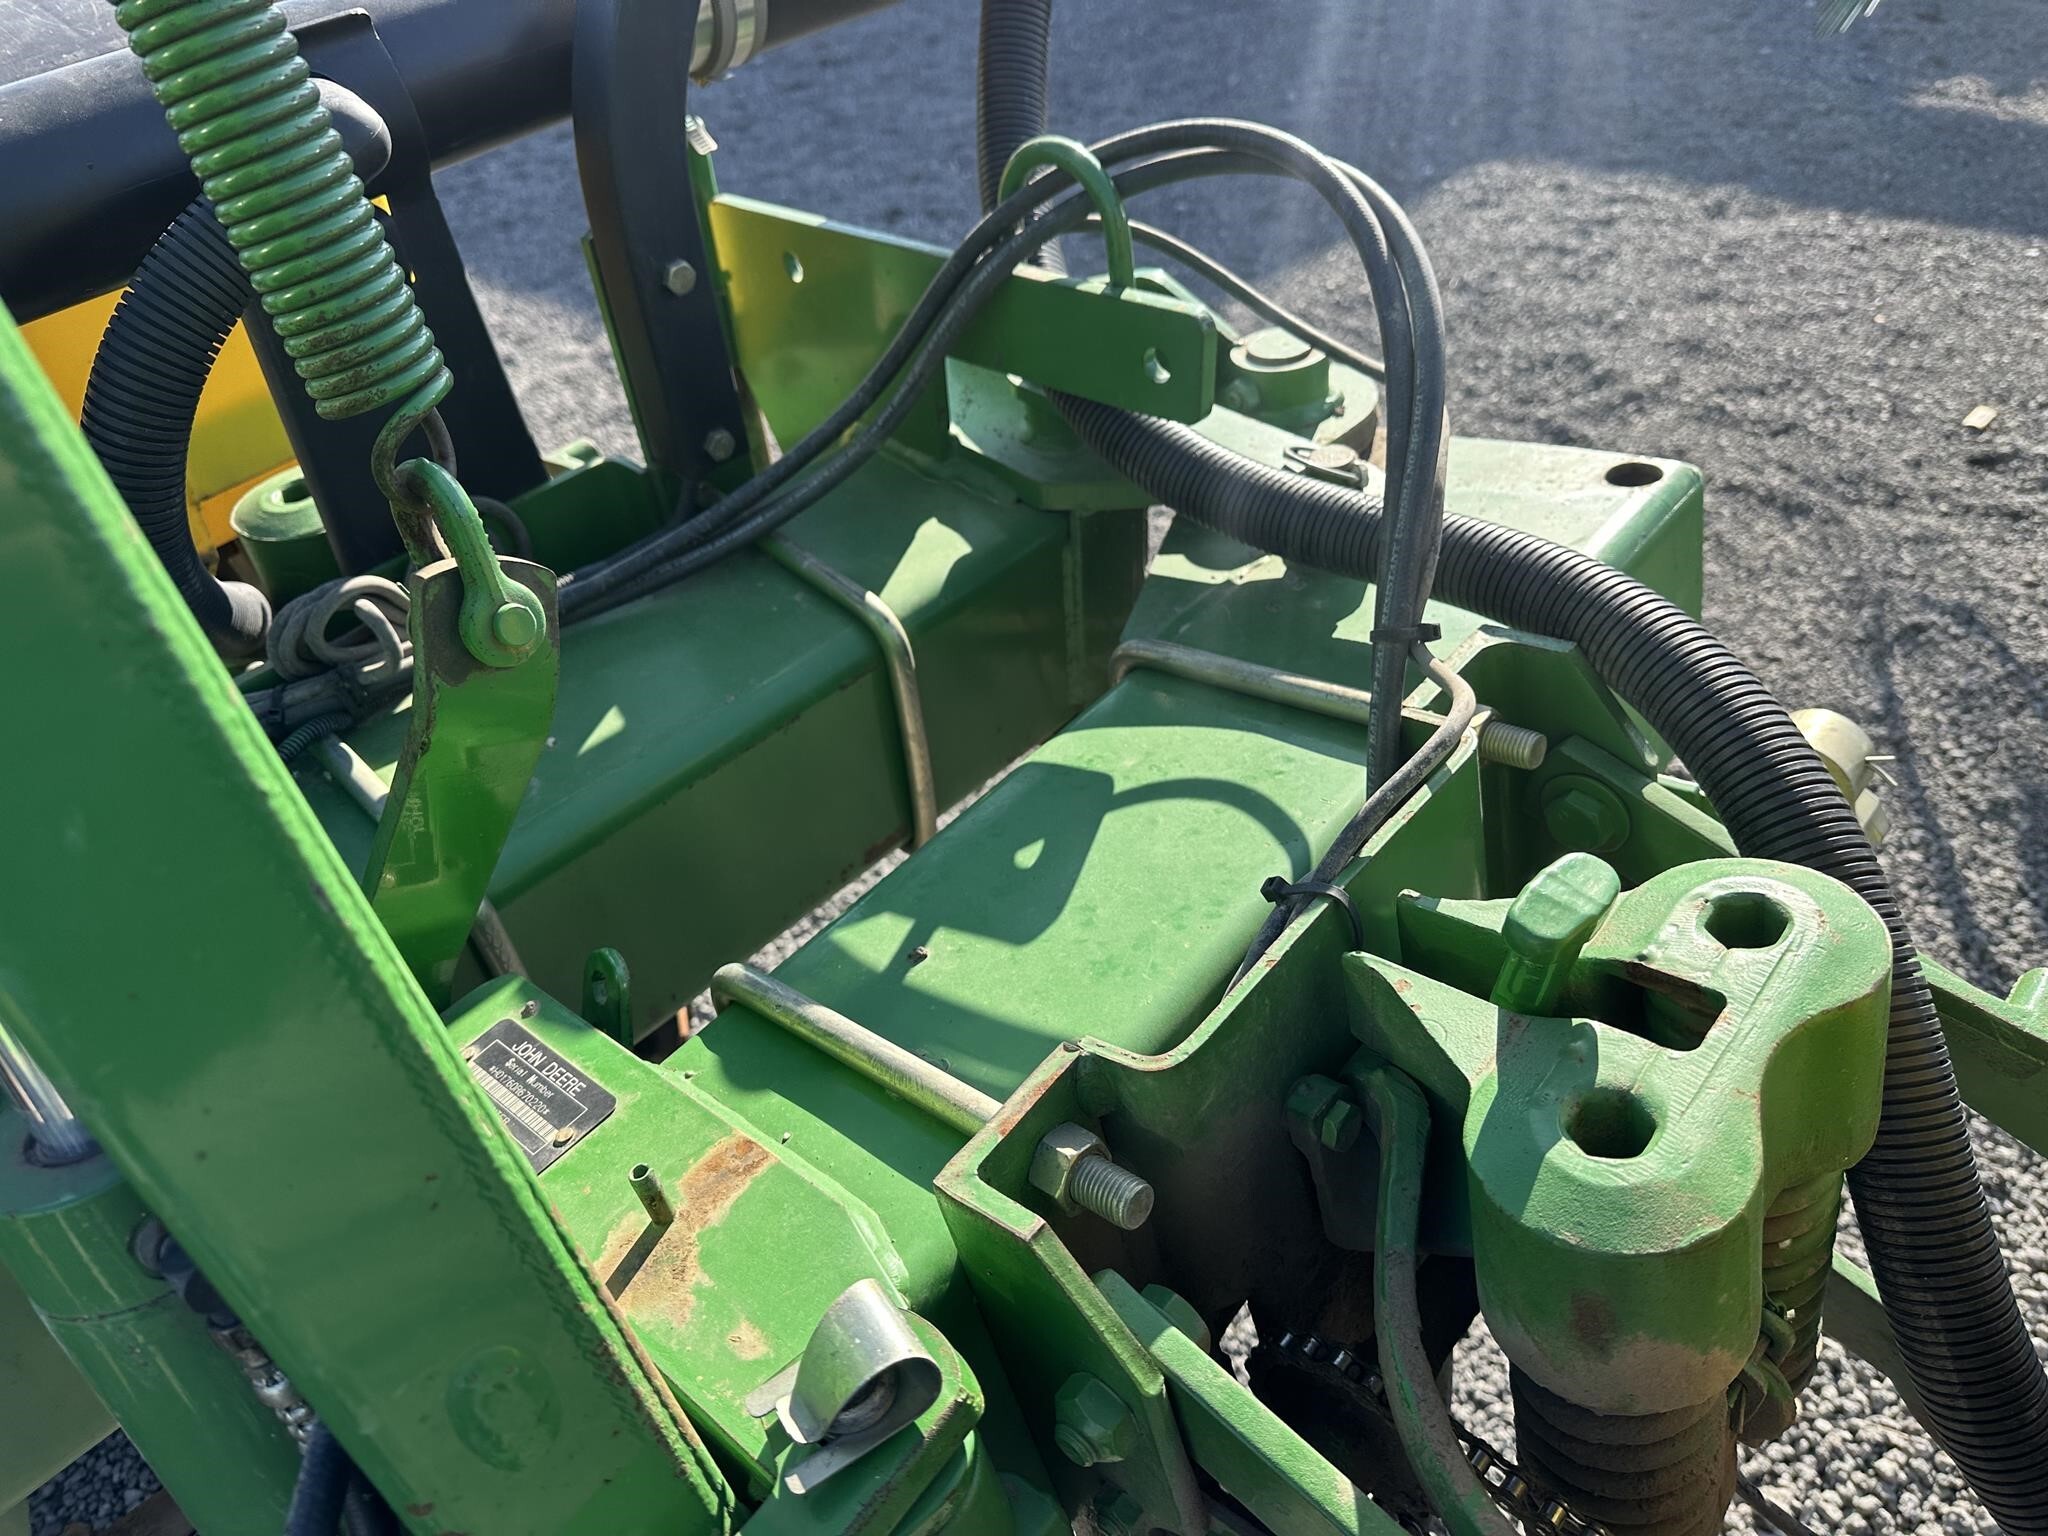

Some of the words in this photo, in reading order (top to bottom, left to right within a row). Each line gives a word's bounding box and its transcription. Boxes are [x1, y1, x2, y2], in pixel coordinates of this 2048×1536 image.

[505, 1058, 528, 1077] Serial
[526, 1073, 555, 1099] Number
[512, 1041, 547, 1067] JOHN
[543, 1061, 586, 1097] DEERE
